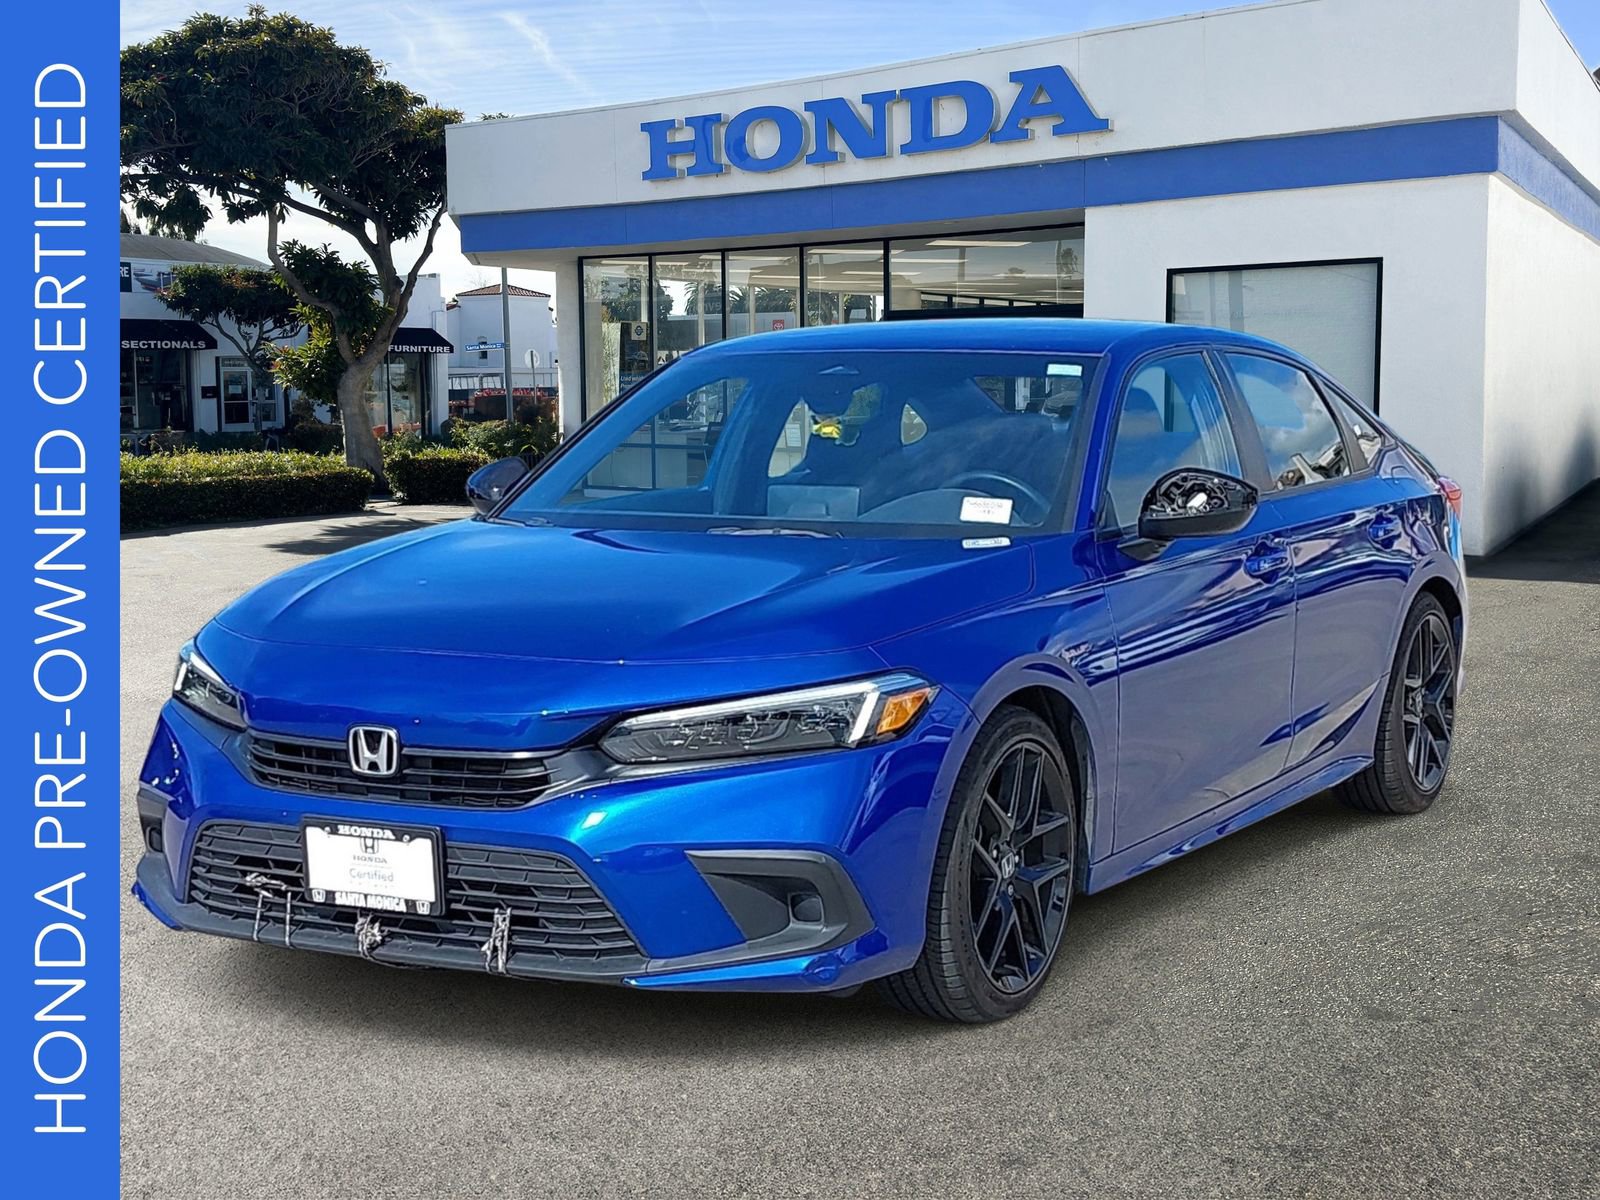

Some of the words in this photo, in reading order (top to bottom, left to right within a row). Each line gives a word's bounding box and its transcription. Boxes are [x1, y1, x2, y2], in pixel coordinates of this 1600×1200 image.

[640, 65, 1111, 181] HONDA
[121, 340, 206, 349] SECTIONALS
[388, 344, 451, 353] FURNITURE
[337, 824, 396, 840] HONDA
[353, 854, 388, 864] HONDA
[349, 867, 394, 882] Certified
[334, 891, 366, 908] SANTA
[366, 893, 407, 913] MONICA
